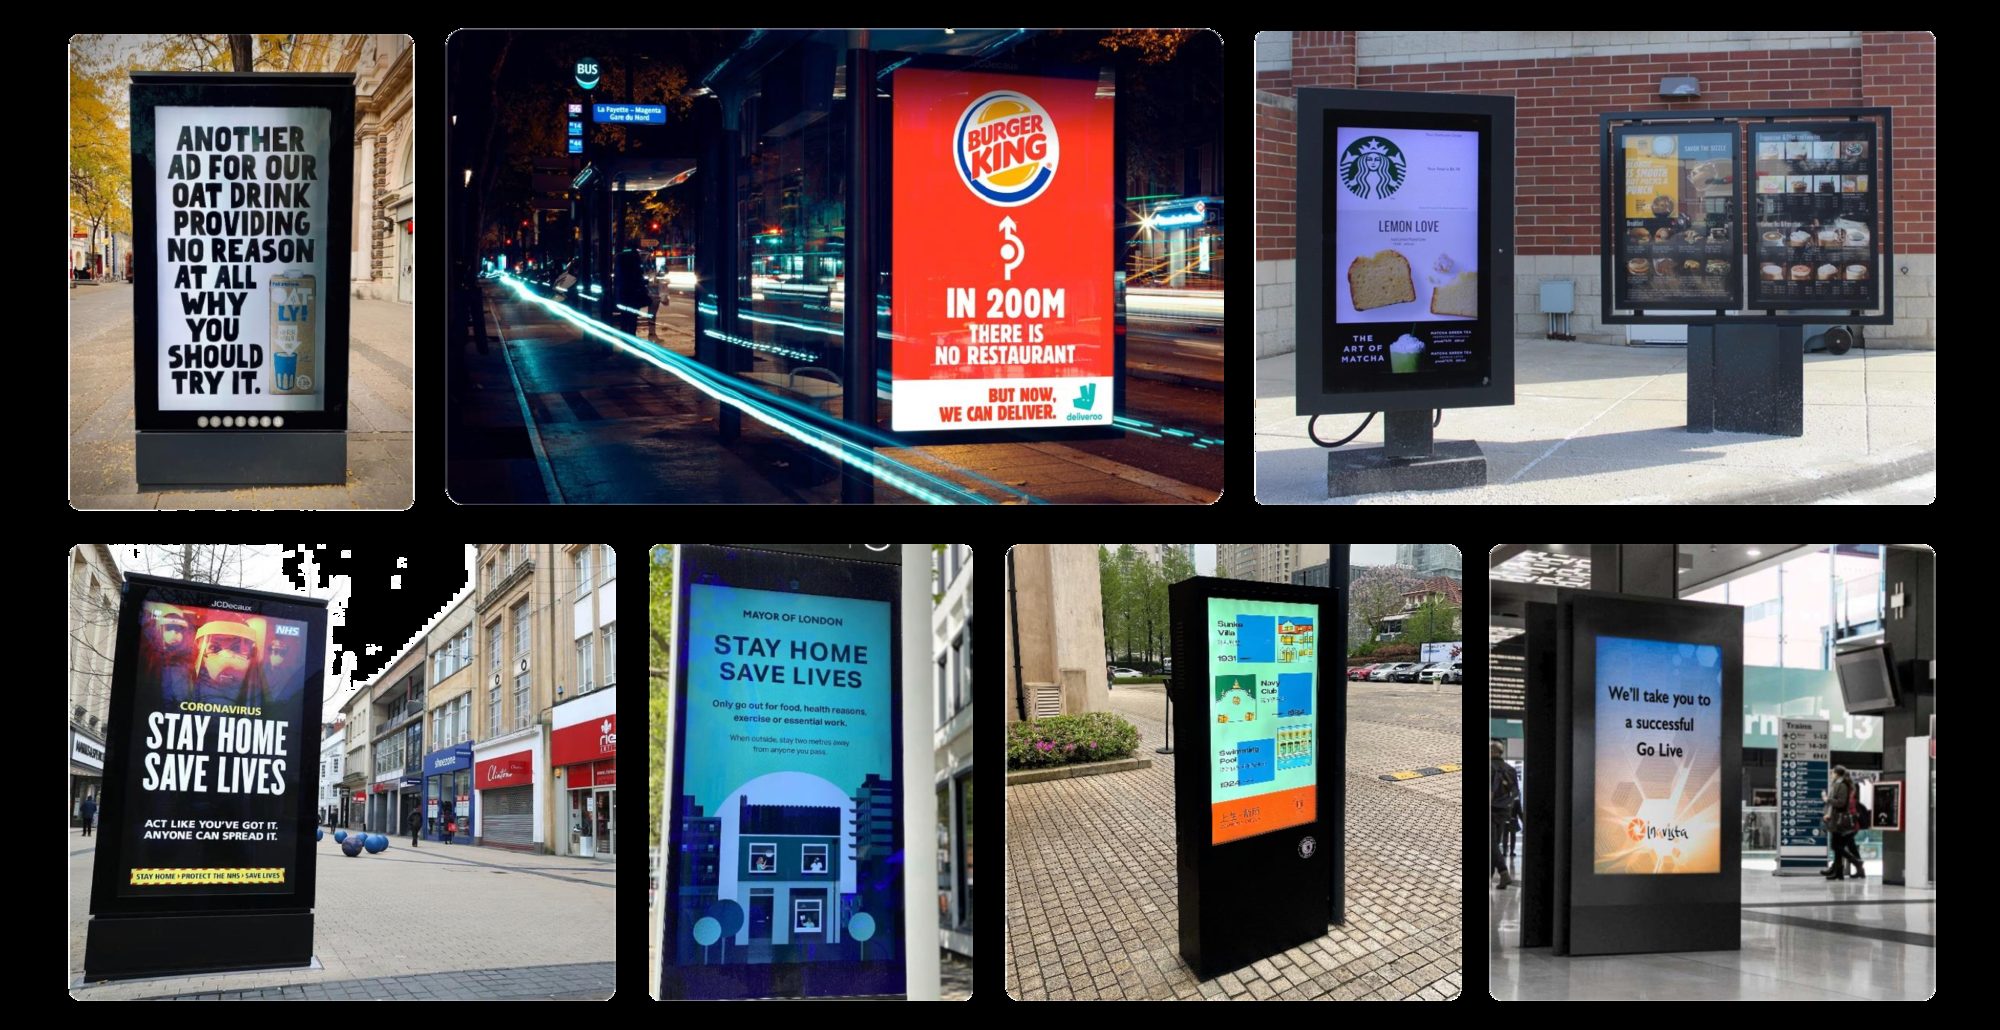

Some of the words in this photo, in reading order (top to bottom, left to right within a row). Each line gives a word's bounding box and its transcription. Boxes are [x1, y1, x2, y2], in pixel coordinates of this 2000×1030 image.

[577, 63, 598, 75] BUS
[635, 106, 661, 114] Magenta
[176, 126, 305, 152] ANOTHER
[967, 114, 1044, 153] BURGER
[971, 134, 1047, 181] KING
[168, 154, 201, 180] AD
[209, 155, 257, 180] FOR
[265, 155, 317, 180] OUR
[172, 183, 222, 208] OAT
[231, 183, 311, 208] DRINK
[174, 210, 310, 236] PROVIDING
[1378, 220, 1412, 233] LEMON
[1415, 220, 1440, 233] LOVE
[168, 238, 204, 262] NO
[212, 238, 314, 263] REASON
[174, 265, 207, 289] AT
[215, 265, 257, 289] ALL
[180, 291, 248, 316] WHY
[946, 287, 976, 319] IN
[986, 287, 1066, 319] 200M
[278, 305, 308, 321] LY!
[186, 317, 239, 343] YOU
[969, 323, 1023, 343] THERE
[1029, 323, 1044, 343] IS
[168, 344, 263, 369] SHOULD
[935, 345, 960, 366] NO
[967, 344, 1076, 366] RESTAURANT
[1343, 345, 1363, 353] ART
[1341, 355, 1385, 363] MATCHA
[172, 371, 224, 394] TRY
[232, 371, 261, 395] IT.
[988, 387, 1016, 403] BUT
[1020, 387, 1057, 404] NOW,
[939, 406, 963, 423] WE
[967, 405, 993, 422] CAN
[998, 404, 1057, 421] DELIVER.
[1066, 411, 1103, 422] deliveroo
[211, 600, 252, 611] JCDecaux
[743, 610, 779, 621] MAYOR
[782, 613, 796, 622] OF
[799, 615, 843, 626] LONDON
[276, 625, 299, 635] NHS
[714, 635, 781, 658] STAY
[790, 640, 868, 664] HOME
[719, 662, 785, 683] SAVE
[793, 666, 862, 688] LIVES
[1608, 685, 1640, 702] We'll
[1643, 689, 1669, 703] take
[1673, 693, 1694, 708] you
[1698, 694, 1711, 706] to
[180, 701, 262, 716] CORONAVIRUS
[712, 699, 733, 709] Only
[735, 702, 747, 710] go
[748, 702, 763, 710] out
[765, 702, 778, 710] for
[780, 702, 802, 712] food,
[803, 704, 830, 714] health
[831, 707, 867, 716] reasons,
[733, 715, 771, 723] exercise
[772, 716, 782, 724] or
[784, 716, 823, 725] essential
[824, 718, 848, 727] work.
[1625, 718, 1632, 728] a
[1636, 717, 1694, 731] successful
[1786, 722, 1812, 730] Trains
[146, 711, 211, 752] STAY
[217, 716, 288, 756] HOME
[730, 734, 750, 742] When
[779, 736, 794, 745] stay
[794, 737, 807, 745] two
[808, 738, 832, 746] metres
[832, 739, 849, 747] away
[753, 745, 769, 753] from
[770, 747, 796, 755] anyone
[1219, 746, 1260, 756] Swimming
[1637, 742, 1655, 757] Go
[1659, 743, 1683, 757] Live
[434, 756, 456, 769] shoezone
[143, 752, 209, 792] SAVE
[217, 756, 287, 796] LIVES
[144, 819, 168, 828] ACT
[170, 819, 196, 829] LIKE
[199, 820, 239, 829] YOU'VE
[242, 821, 264, 830] GOT
[267, 821, 279, 830] IT.
[1647, 821, 1688, 840] inavista
[143, 831, 193, 840] ANYONE
[195, 831, 219, 840] CAN
[222, 831, 264, 841] SPREAD
[266, 831, 278, 841] IT.
